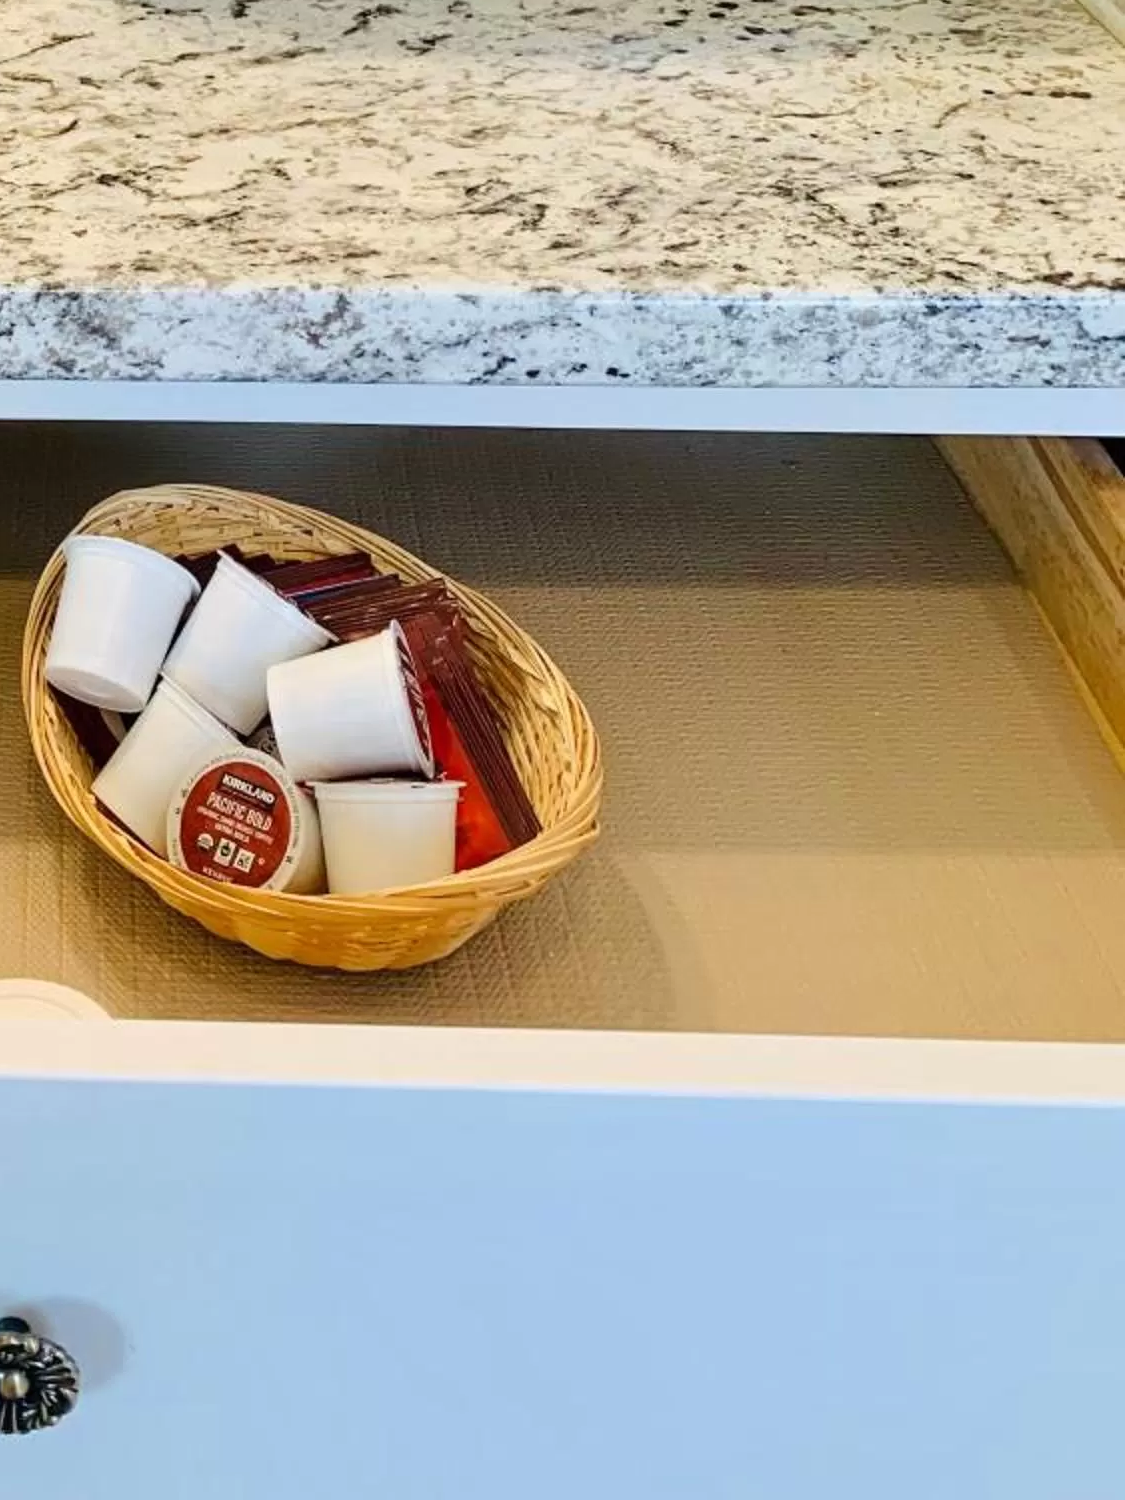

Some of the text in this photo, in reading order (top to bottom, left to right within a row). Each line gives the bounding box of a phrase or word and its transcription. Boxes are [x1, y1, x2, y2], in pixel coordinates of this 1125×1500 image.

[222, 774, 275, 805] KIRKLAND
[206, 791, 274, 832] PACIFIC BOLD
